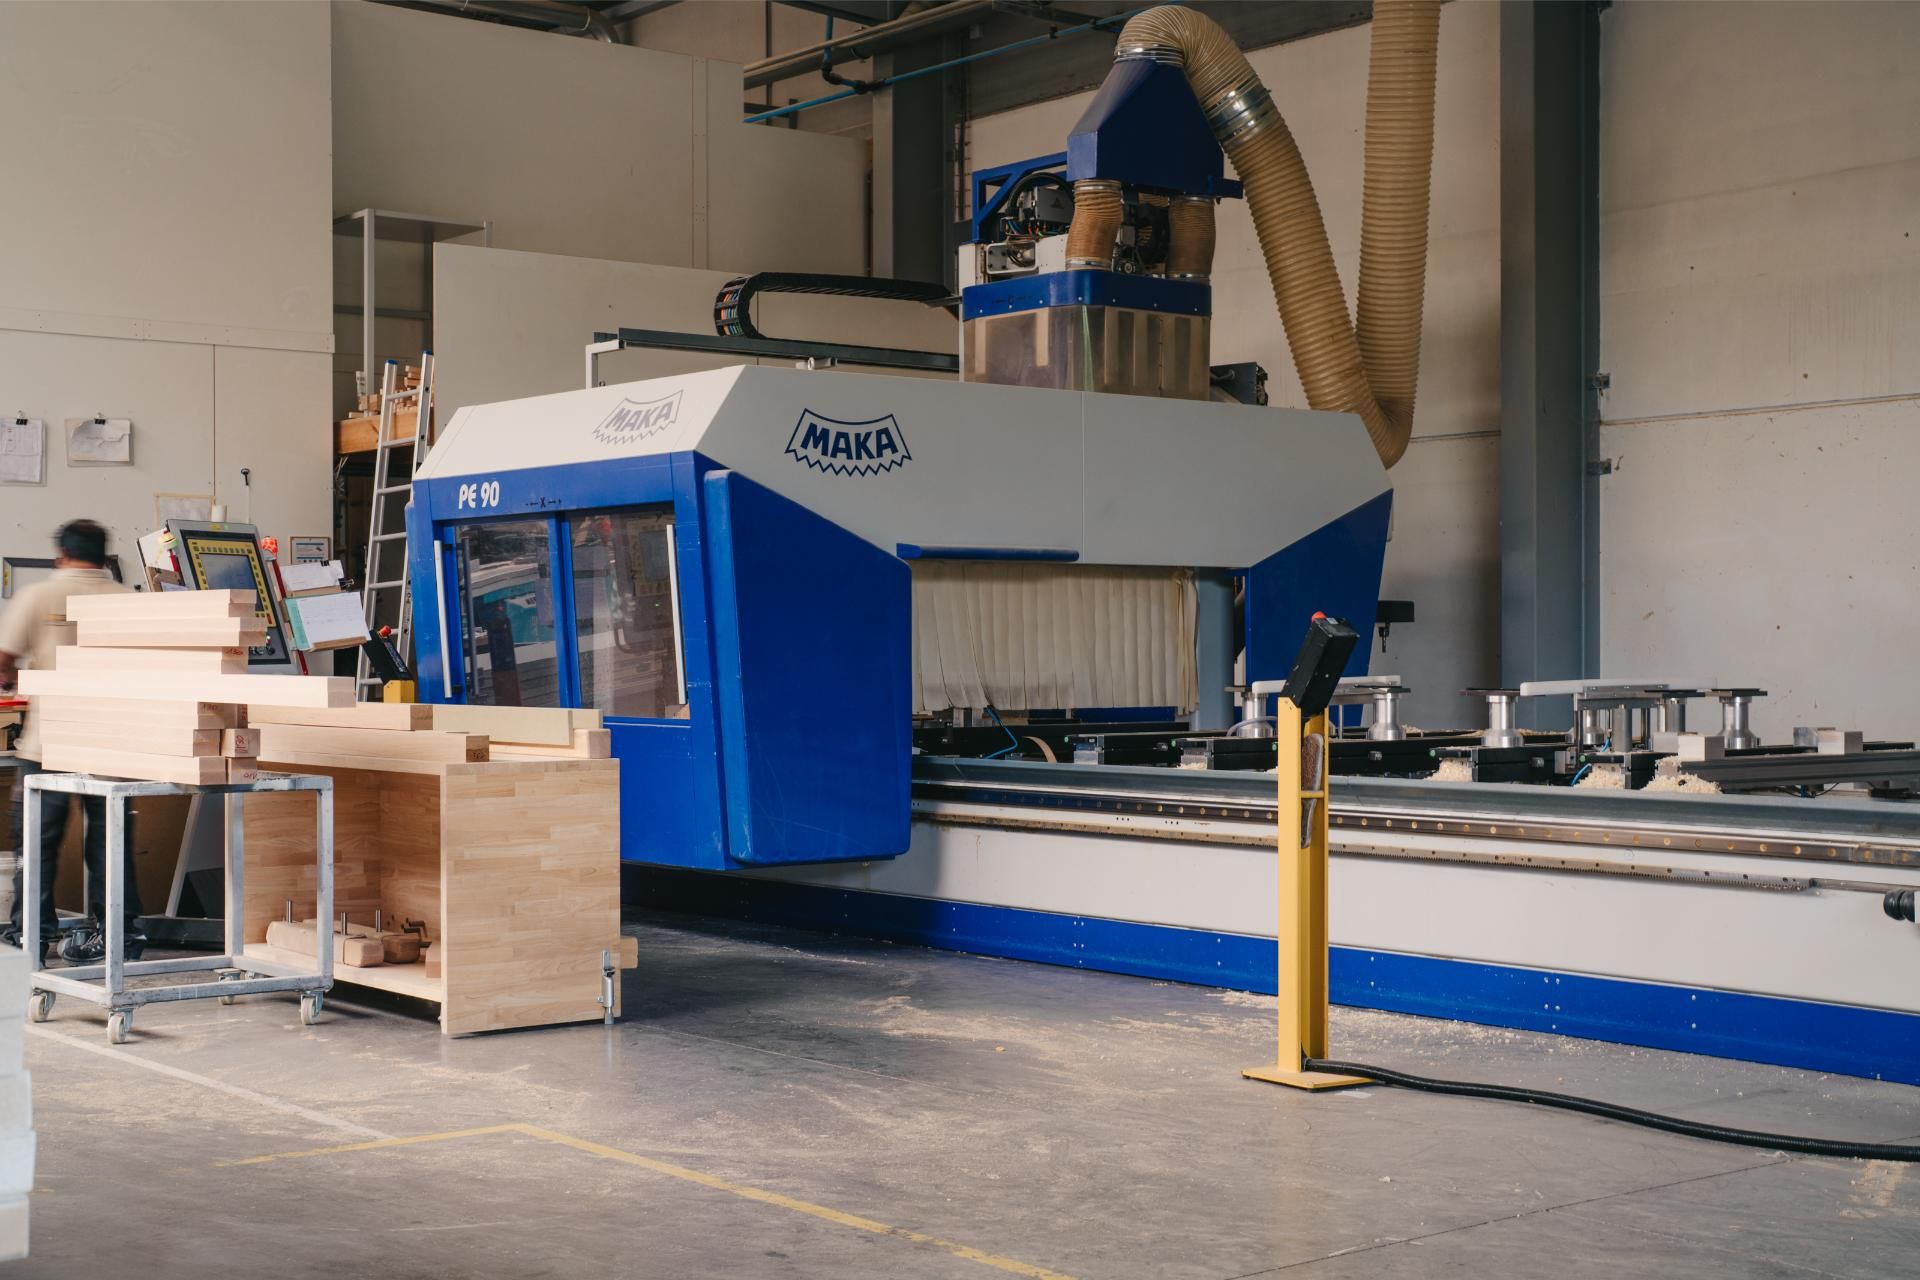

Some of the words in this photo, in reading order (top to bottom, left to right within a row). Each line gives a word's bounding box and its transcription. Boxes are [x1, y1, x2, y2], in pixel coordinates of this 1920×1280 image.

[605, 400, 674, 432] MAKA
[800, 422, 899, 460] MAKA
[458, 483, 477, 509] PE
[481, 481, 500, 508] 90
